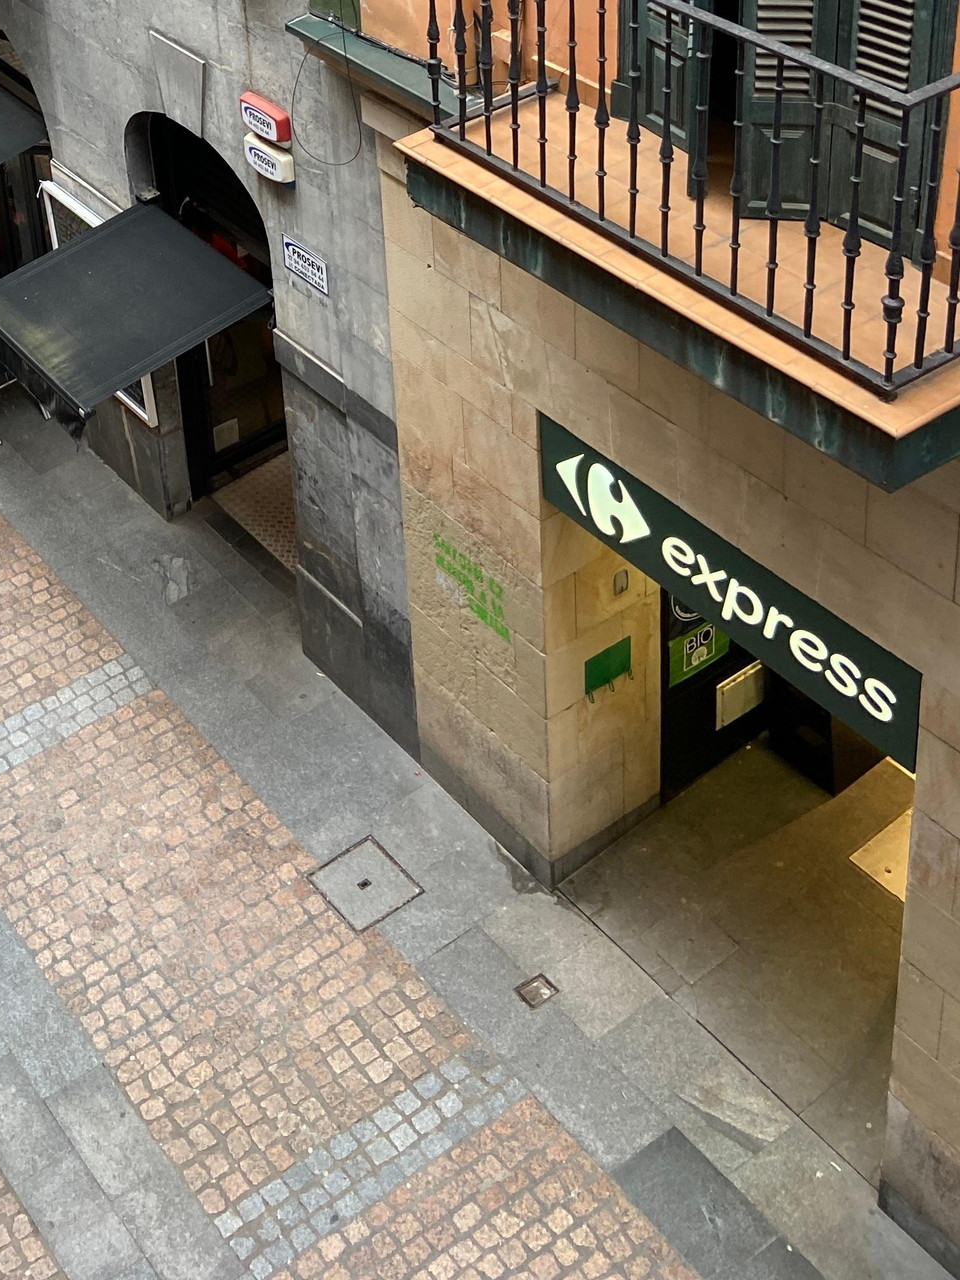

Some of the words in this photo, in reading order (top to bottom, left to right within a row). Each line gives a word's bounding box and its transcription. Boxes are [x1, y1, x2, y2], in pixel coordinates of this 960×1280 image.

[248, 110, 272, 131] PROSEVI
[253, 150, 277, 171] PROSEVI
[292, 247, 323, 276] PROSEVI
[294, 265, 325, 290] CONECTADA
[662, 536, 898, 723] express
[686, 627, 713, 654] BIO
